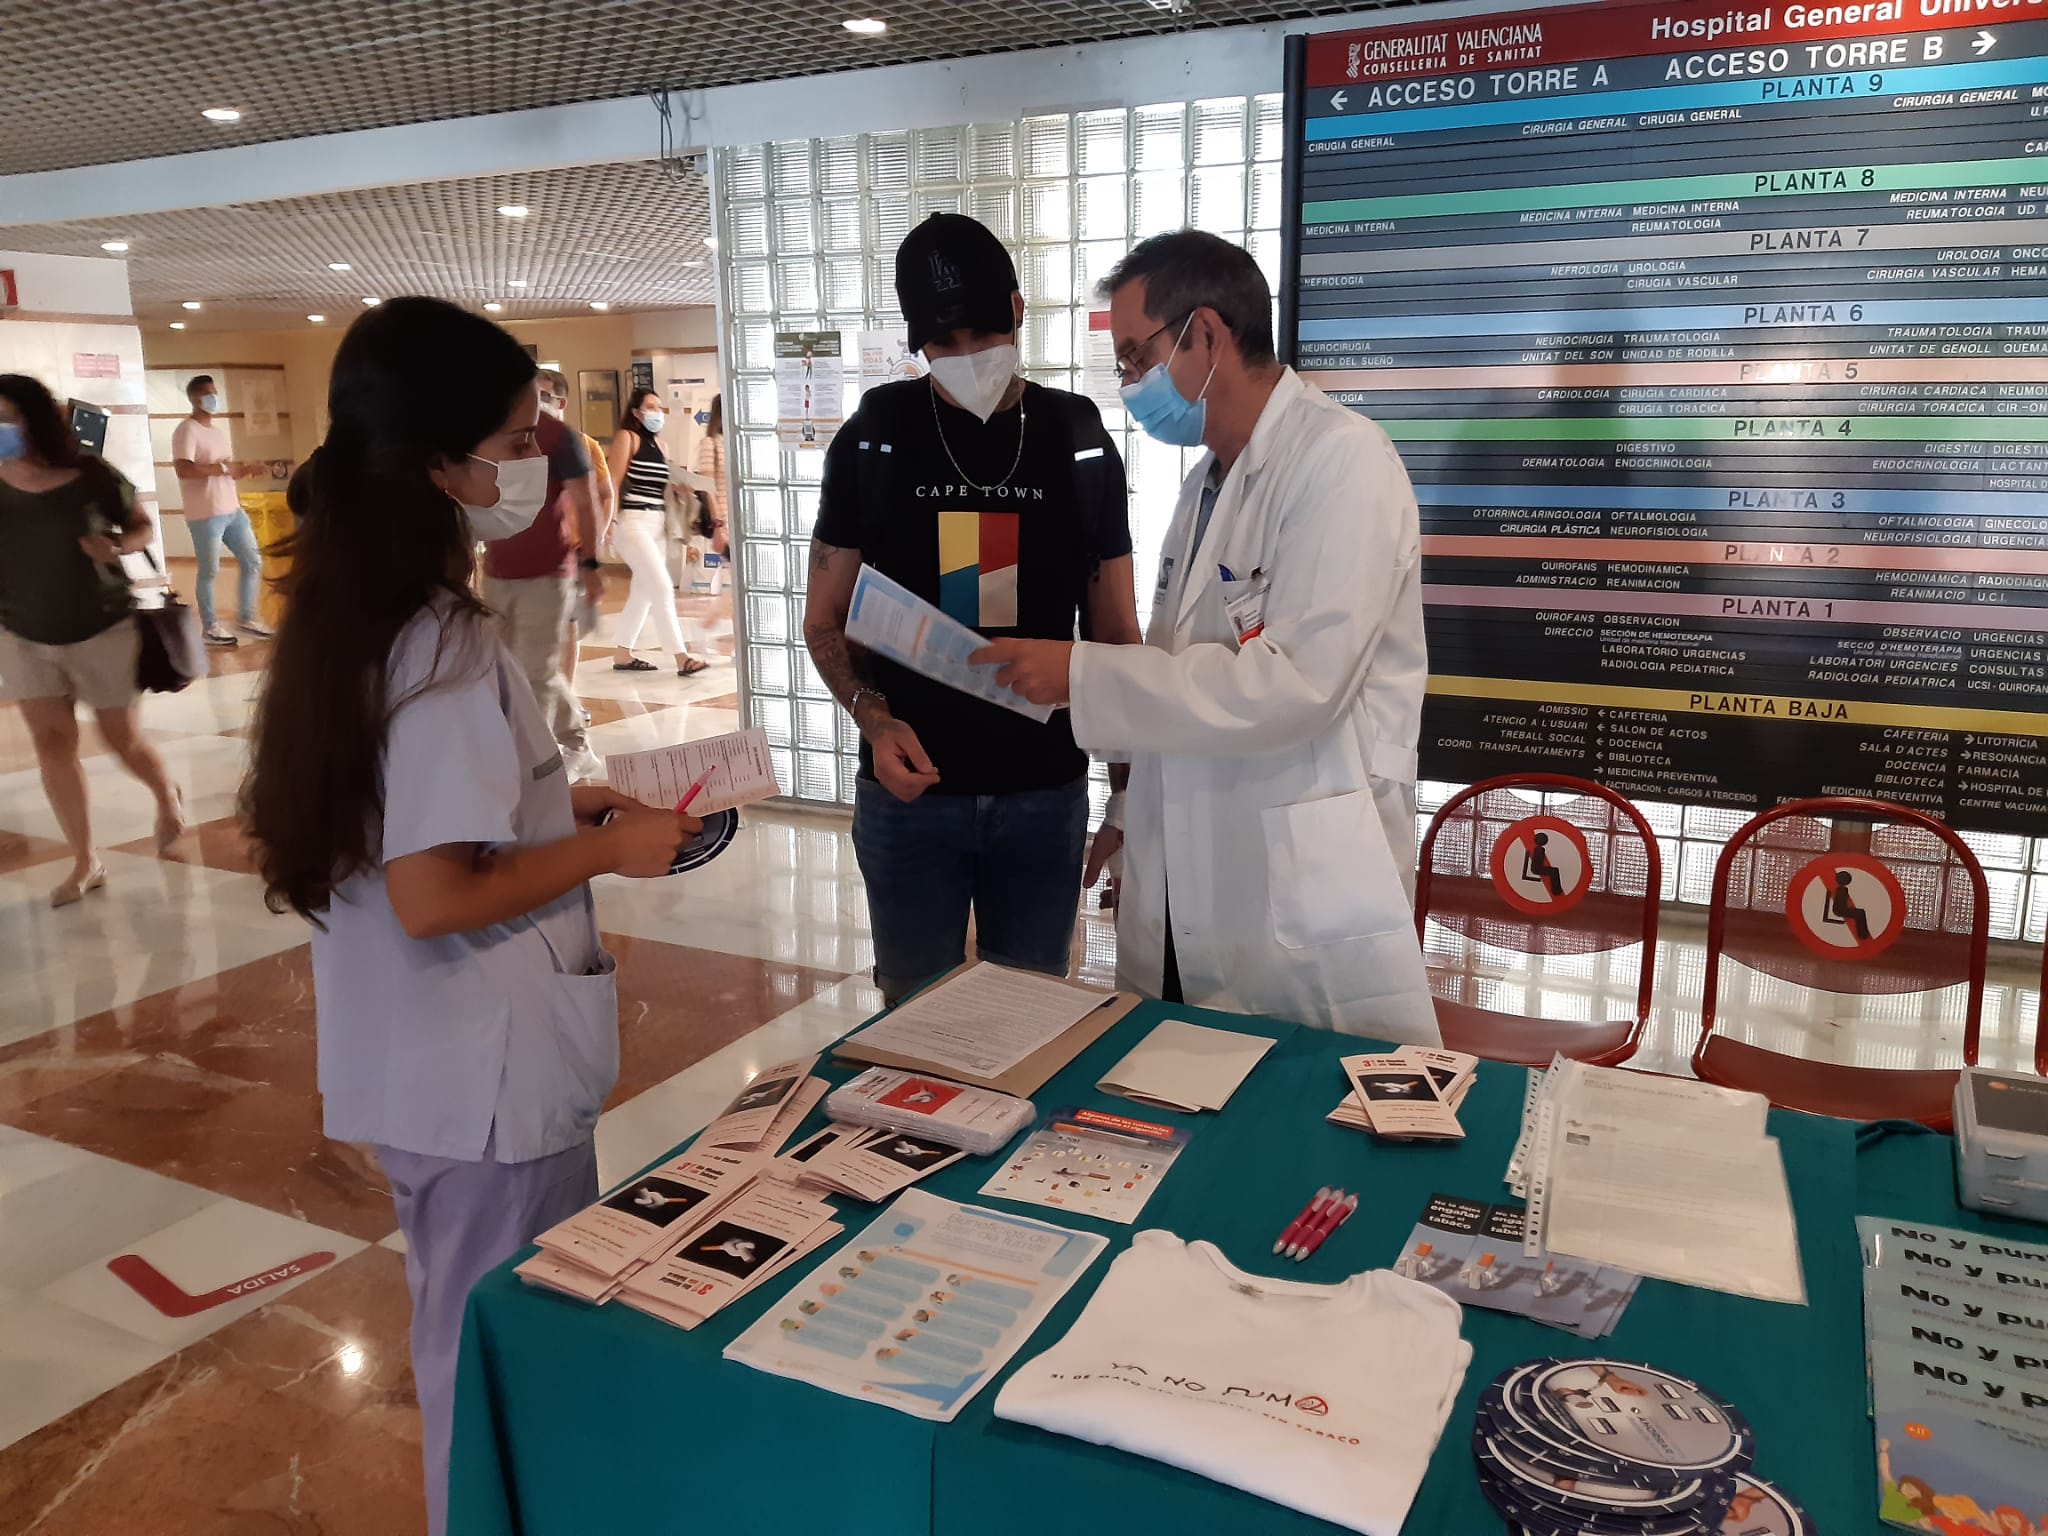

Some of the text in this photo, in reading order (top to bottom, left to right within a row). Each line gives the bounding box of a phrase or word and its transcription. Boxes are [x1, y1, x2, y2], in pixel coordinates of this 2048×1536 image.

[1651, 0, 1902, 40] Hospital General
[1364, 22, 1542, 61] GENERALITAT VALENCIANA
[1363, 46, 1542, 76] CONSELLERIA DE SANITAT
[1664, 36, 1944, 80] ACCESO TORRE B
[1368, 64, 1609, 108] ACCESO TORRE A
[1762, 74, 1882, 99] PLANTA 9
[1893, 90, 2018, 108] CIRURGIA GENERAL
[1578, 117, 1628, 131] GENERAL
[1639, 109, 1742, 126] CIRUGIA GENERAL
[1309, 138, 1395, 152] CIRUGIA GENERAL
[1755, 169, 1874, 192] PLANTA 8
[1890, 189, 2007, 204] MEDICINA INTERNA
[1633, 201, 1739, 216] MEDICINA INTERNA
[1907, 206, 2005, 219] REUMATOLOGIA
[1520, 208, 1622, 223] MEDICINA INTERNA
[1306, 222, 1395, 236] MEDICINA INTERNA
[1632, 219, 1722, 232] REUMATOLOGIA
[1751, 229, 1869, 250] PLANTA 7
[1937, 250, 2000, 260] UROLOGIA
[1551, 264, 1618, 276] NEFROLOGIA
[1628, 262, 1686, 272] UROLOGIA
[1867, 266, 2000, 280] CIRURGIA VASCULAR
[1677, 276, 1737, 286] VASCULAR
[1744, 304, 1862, 324] PLANTA 6
[1624, 332, 1720, 343] TRAUMATOLOGIA
[1888, 326, 1992, 338] TRAUMATOLOGIA
[1622, 348, 1735, 360] UNIDAD DE RODILLA
[1869, 344, 1991, 354] UNITAT DE GENOLL
[1301, 358, 1356, 366] UNIDAD DEL
[1522, 350, 1613, 362] UNITAT DEL SON
[1845, 362, 1858, 379] 5
[1538, 390, 1610, 400] CARDIOLOGIA
[1670, 388, 1727, 398] CARDIACA
[1924, 386, 1987, 396] CARDIACA
[1922, 402, 1985, 412] TORACICA
[1734, 420, 1852, 436] PLANTA 4
[1616, 443, 1675, 453] DIGESTIVO
[1522, 458, 1604, 467] DERMATOLOGIA
[1615, 458, 1712, 468] ENDOCRINOLOGIA
[1873, 460, 1979, 470] ENDOCRINOLOGIA
[916, 485, 1042, 500] CAPE TOWN
[1729, 491, 1845, 508] PLANTA 3
[1611, 512, 1696, 522] OFTALMOLOGIA
[1879, 517, 1974, 528] OFTALMOLOGIA
[1610, 526, 1708, 537] NEUROFISIOLOGIA
[1863, 532, 1971, 544] NEUROFISIOLOGIA
[1828, 548, 1840, 563] 2
[1542, 562, 1597, 572] QUIROFANS
[1608, 563, 1690, 575] HEMODINAMICA
[1607, 578, 1680, 590] REANIMACION
[1875, 572, 1968, 584] HEMODINAMICA
[1890, 588, 1966, 600] REANIMACIO
[1722, 598, 1833, 618] PLANTA 1
[1535, 612, 1594, 623] QUIROFANS
[1604, 615, 1680, 626] OBSERVACION
[1545, 627, 1593, 637] DIRECCIO
[1883, 628, 1961, 640] OBSERVACIO
[1974, 632, 2044, 644] URGENCIAS
[1602, 645, 1746, 660] LABORATORIO URGENCIAS
[1971, 649, 2040, 660] URGENCIAS
[1601, 659, 1734, 675] RADIOLOGIA PEDIATRICA
[1809, 656, 1958, 672] LABORATORI URGENCIES
[1969, 665, 2044, 677] CONSULTAS
[1808, 671, 1955, 688] RADIOLOGIA PEDIATRICA
[1539, 705, 1588, 716] ADMISSIO
[1690, 694, 1848, 720] PLANTA BAJA
[1483, 715, 1526, 725] ATENCIO
[1609, 710, 1668, 722] CAFETERIA
[1500, 730, 1586, 744] TREBALL SOCIAL
[1610, 724, 1708, 740] SALON DE ACTOS
[1884, 729, 1949, 742] CAFETERIA
[1479, 742, 1585, 758] TRANSPLANTAMENTS
[1609, 738, 1663, 750] DOCENCIA
[1859, 742, 1890, 754] SALA
[1609, 752, 1671, 766] BIBLIOTECA
[1885, 760, 1946, 773] DOCENCIA
[1958, 765, 2019, 778] FARMACIA
[1607, 767, 1718, 784] MEDICINA PREVENTIVA
[1875, 774, 1944, 788] BIBLIOTECA
[1822, 785, 1943, 804] MEDICINA PREVENTIVA
[1970, 783, 2043, 796] HOSPITAL DE
[1429, 1216, 1471, 1230] tabaco
[1891, 1227, 2048, 1262] No y pun
[1904, 1249, 1951, 1268] No
[1964, 1264, 1983, 1278] y
[226, 1265, 301, 1294] SALIDA
[1901, 1284, 1950, 1306] No
[1963, 1303, 1983, 1318] y
[1912, 1326, 1999, 1362] No y
[1164, 1376, 1206, 1391] NO
[1913, 1361, 1968, 1385] No
[1982, 1381, 2005, 1398] y
